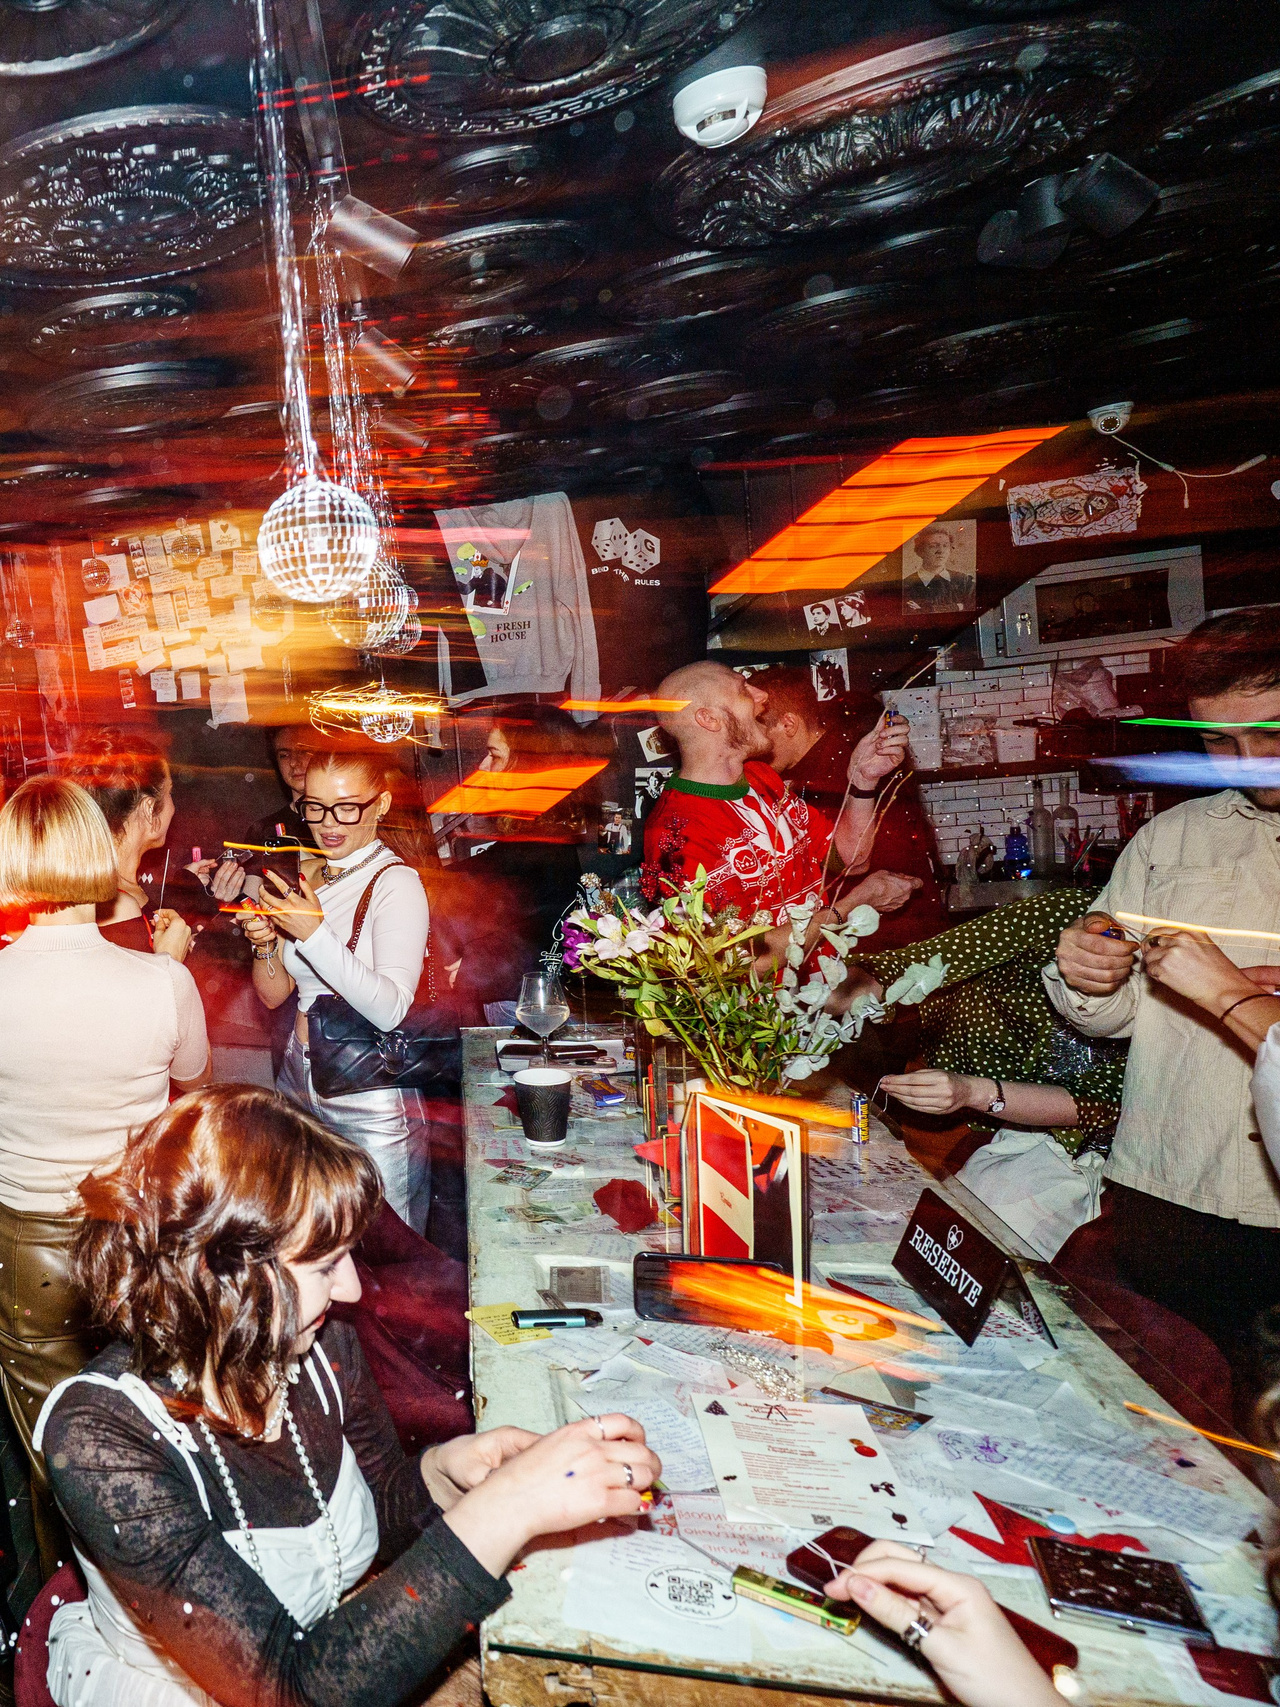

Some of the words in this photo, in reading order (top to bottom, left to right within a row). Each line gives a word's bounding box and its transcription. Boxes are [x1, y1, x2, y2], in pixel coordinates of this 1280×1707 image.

[613, 568, 630, 582] THE
[634, 579, 661, 587] RULES
[496, 620, 531, 632] FRESH
[491, 631, 527, 643] HOUSE
[908, 1224, 983, 1307] RESERVE
